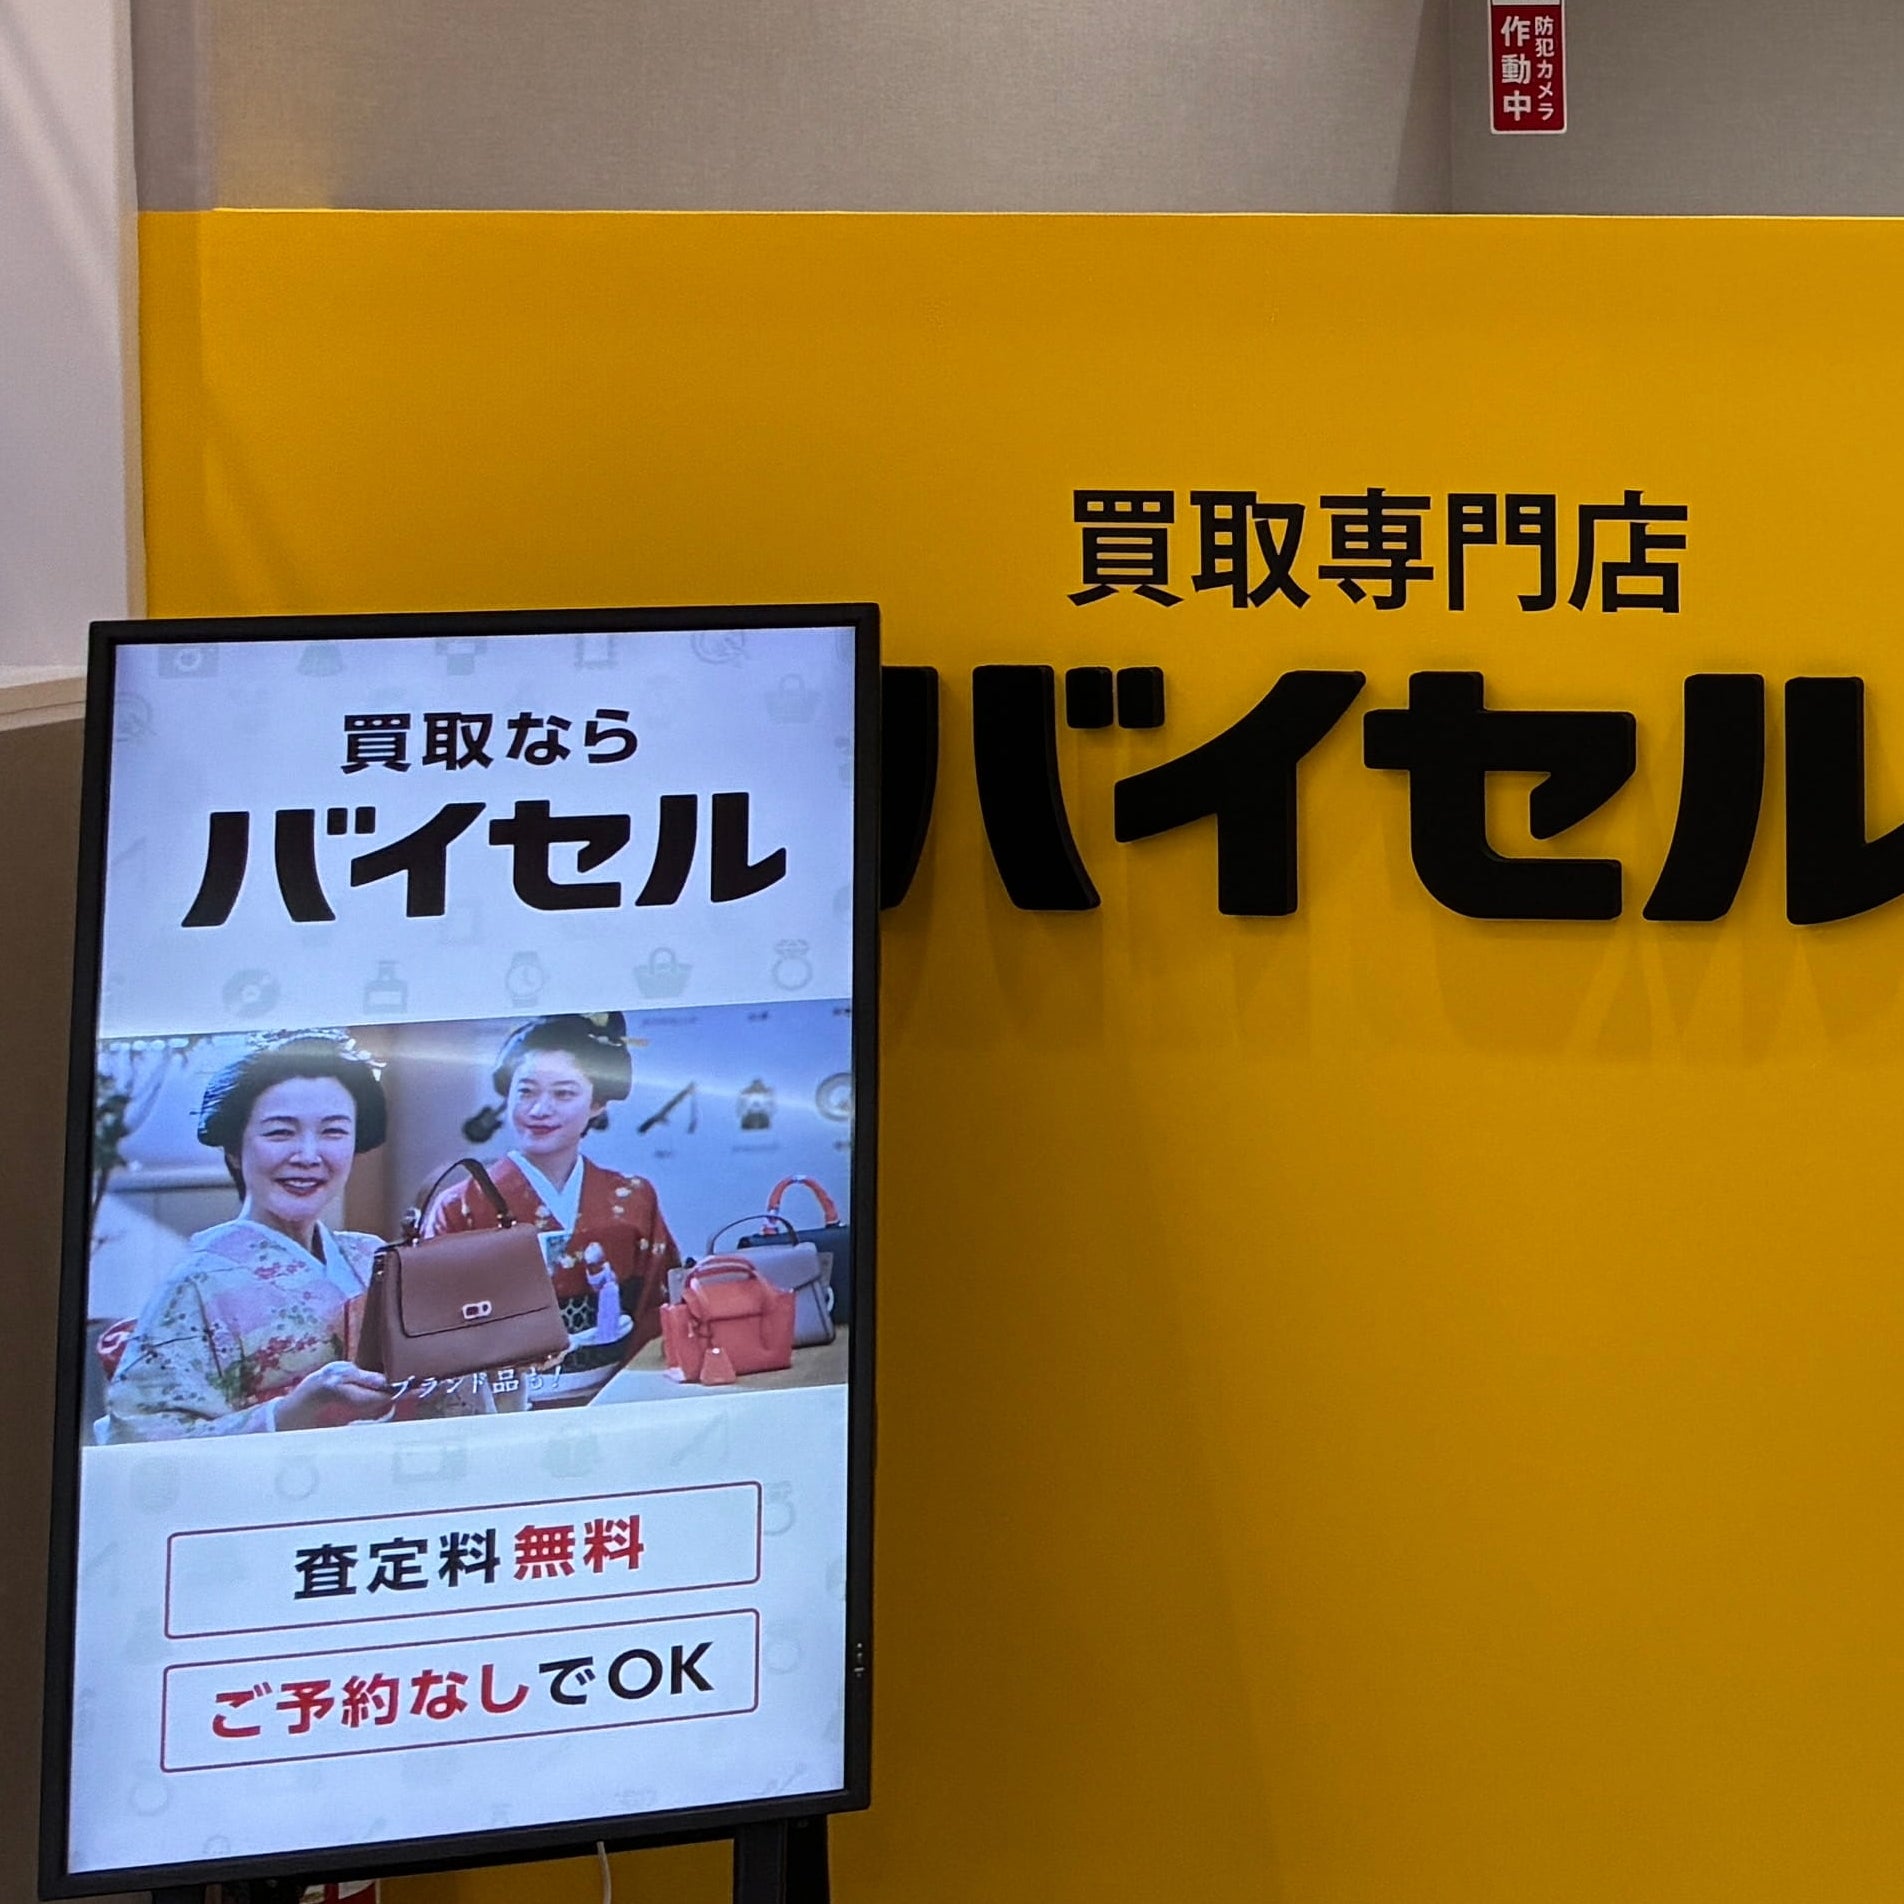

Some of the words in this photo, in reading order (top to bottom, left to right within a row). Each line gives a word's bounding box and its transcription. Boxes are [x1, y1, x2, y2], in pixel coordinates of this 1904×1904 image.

[1501, 15, 1531, 122] 作動中
[1534, 16, 1555, 121] 防犯カメラ
[1067, 487, 1689, 614] 買取専門店
[340, 708, 641, 775] 買取なら
[181, 792, 788, 928] バイセル
[391, 1366, 561, 1400] ブランド品も!
[293, 1515, 646, 1602] 査定料無料
[211, 1641, 716, 1741] ご予約なしでOK
